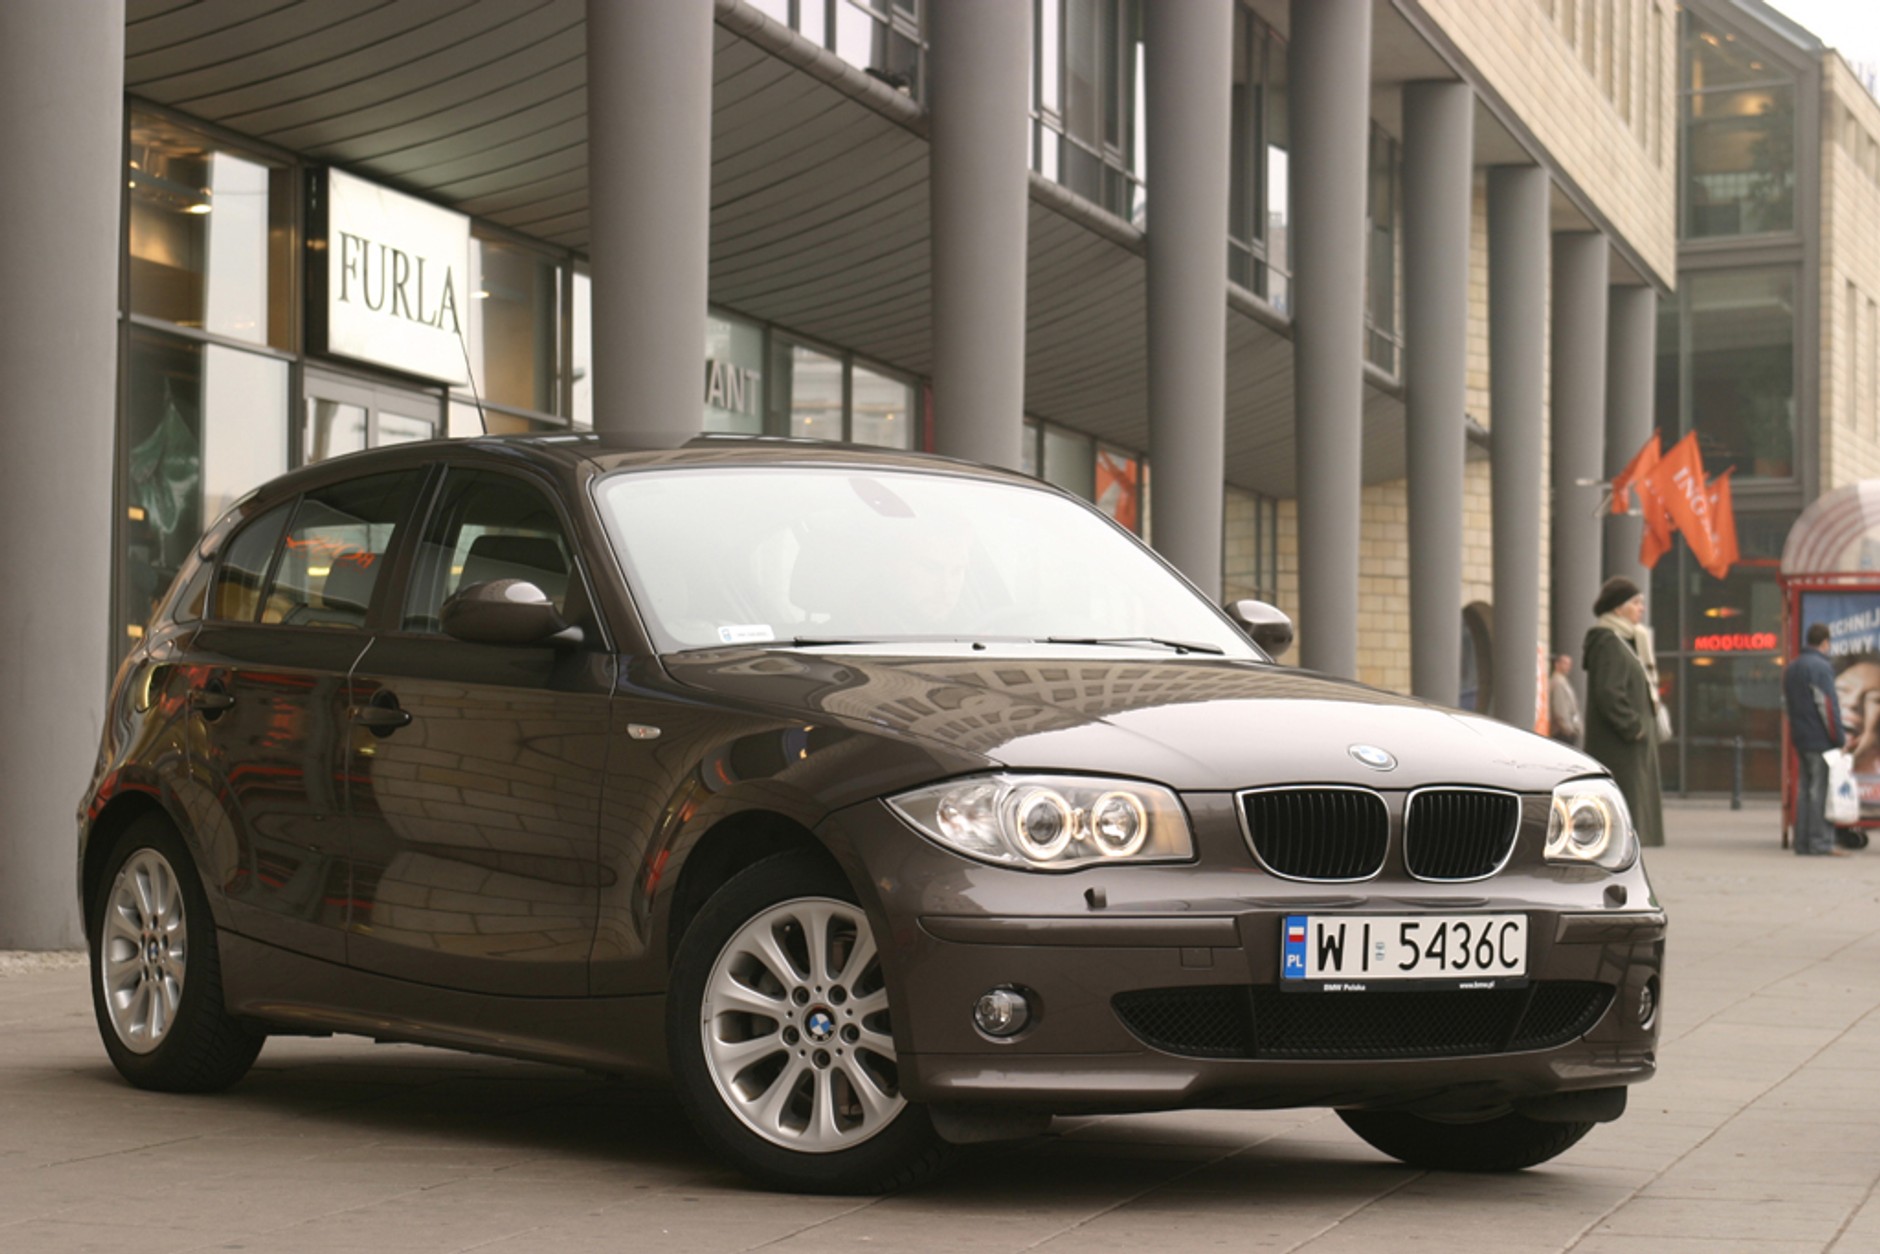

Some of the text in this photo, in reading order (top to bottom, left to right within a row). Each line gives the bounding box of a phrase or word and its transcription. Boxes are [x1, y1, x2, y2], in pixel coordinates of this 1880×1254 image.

[338, 230, 463, 335] FURLA
[706, 359, 761, 417] ANT
[1672, 465, 1708, 516] ING
[1286, 954, 1304, 968] PL
[1398, 921, 1519, 971] 5436C
